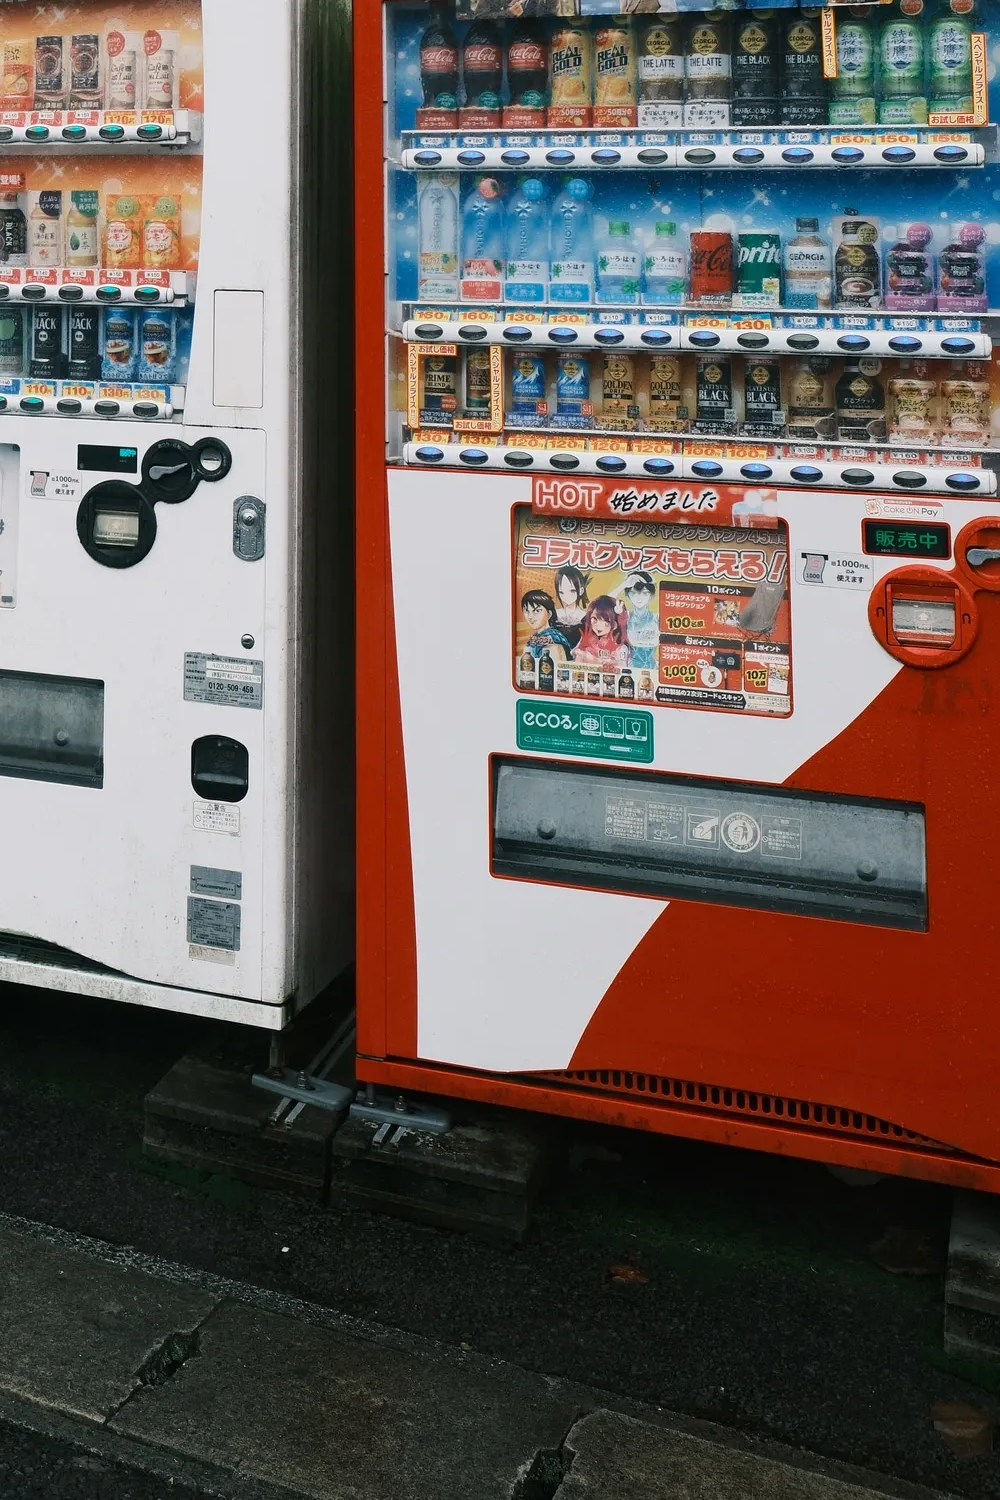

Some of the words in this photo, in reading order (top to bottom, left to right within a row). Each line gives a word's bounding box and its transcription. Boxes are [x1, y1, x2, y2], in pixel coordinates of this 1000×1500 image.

[553, 47, 582, 60] REAL
[597, 45, 626, 61] REAL
[643, 59, 655, 67] THE
[656, 59, 675, 68] LATTE
[689, 58, 701, 66] THE
[702, 57, 722, 67] LATTE
[737, 56, 748, 65] THE
[749, 56, 771, 64] BLACK
[785, 55, 796, 63] THE
[797, 54, 820, 64] BLACK
[553, 59, 582, 73] GOLD
[598, 57, 628, 73] GOLD
[931, 115, 975, 125] お試し価格
[789, 252, 826, 262] GEORGIA
[511, 288, 537, 297] 天然水
[556, 288, 583, 297] 天然水
[690, 318, 725, 327] 130円
[734, 320, 771, 329] 130円
[418, 346, 455, 354] お試し価格
[603, 380, 633, 390] GOLDEN
[651, 381, 681, 391] GOLDEN
[699, 390, 729, 401] BLACK
[747, 391, 777, 403] BLACK
[455, 421, 492, 430] お試し価格
[415, 434, 447, 443] 130円
[463, 436, 496, 445] 130円
[535, 481, 603, 511] HOT
[610, 489, 717, 512] 始めました
[922, 508, 938, 517] Pay
[875, 530, 938, 549] 販売中
[524, 536, 787, 585] コラボグッズもらえる!
[836, 575, 864, 584] 使えます
[706, 585, 741, 595] 10ポイント
[753, 642, 781, 653] 1ポイント
[663, 666, 696, 677] 1,000
[746, 670, 767, 680] 10万
